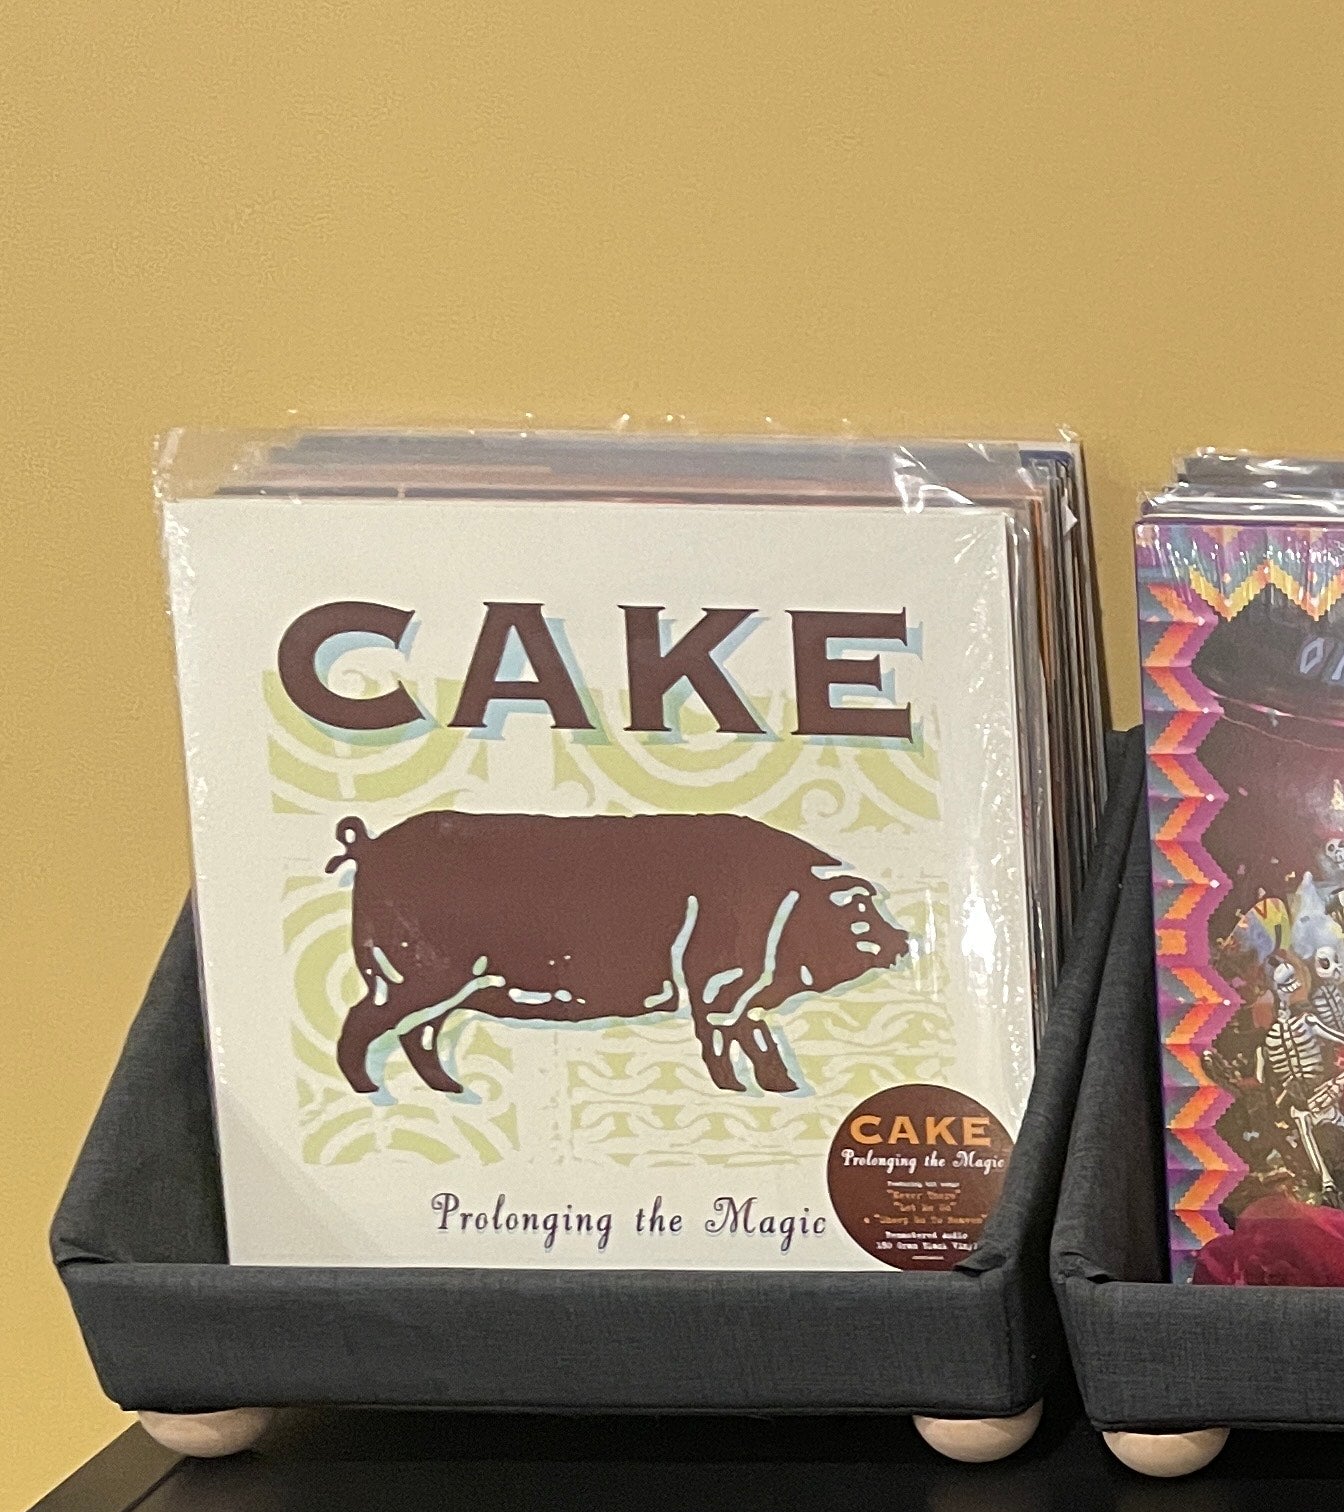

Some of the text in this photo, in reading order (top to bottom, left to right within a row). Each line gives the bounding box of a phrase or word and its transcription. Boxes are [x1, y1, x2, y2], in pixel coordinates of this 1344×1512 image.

[277, 600, 922, 750] CAKE
[849, 1115, 991, 1147] CAKE
[841, 1149, 1005, 1175] Prolonging the Magic
[432, 1194, 827, 1254] Prolonging the Magic
